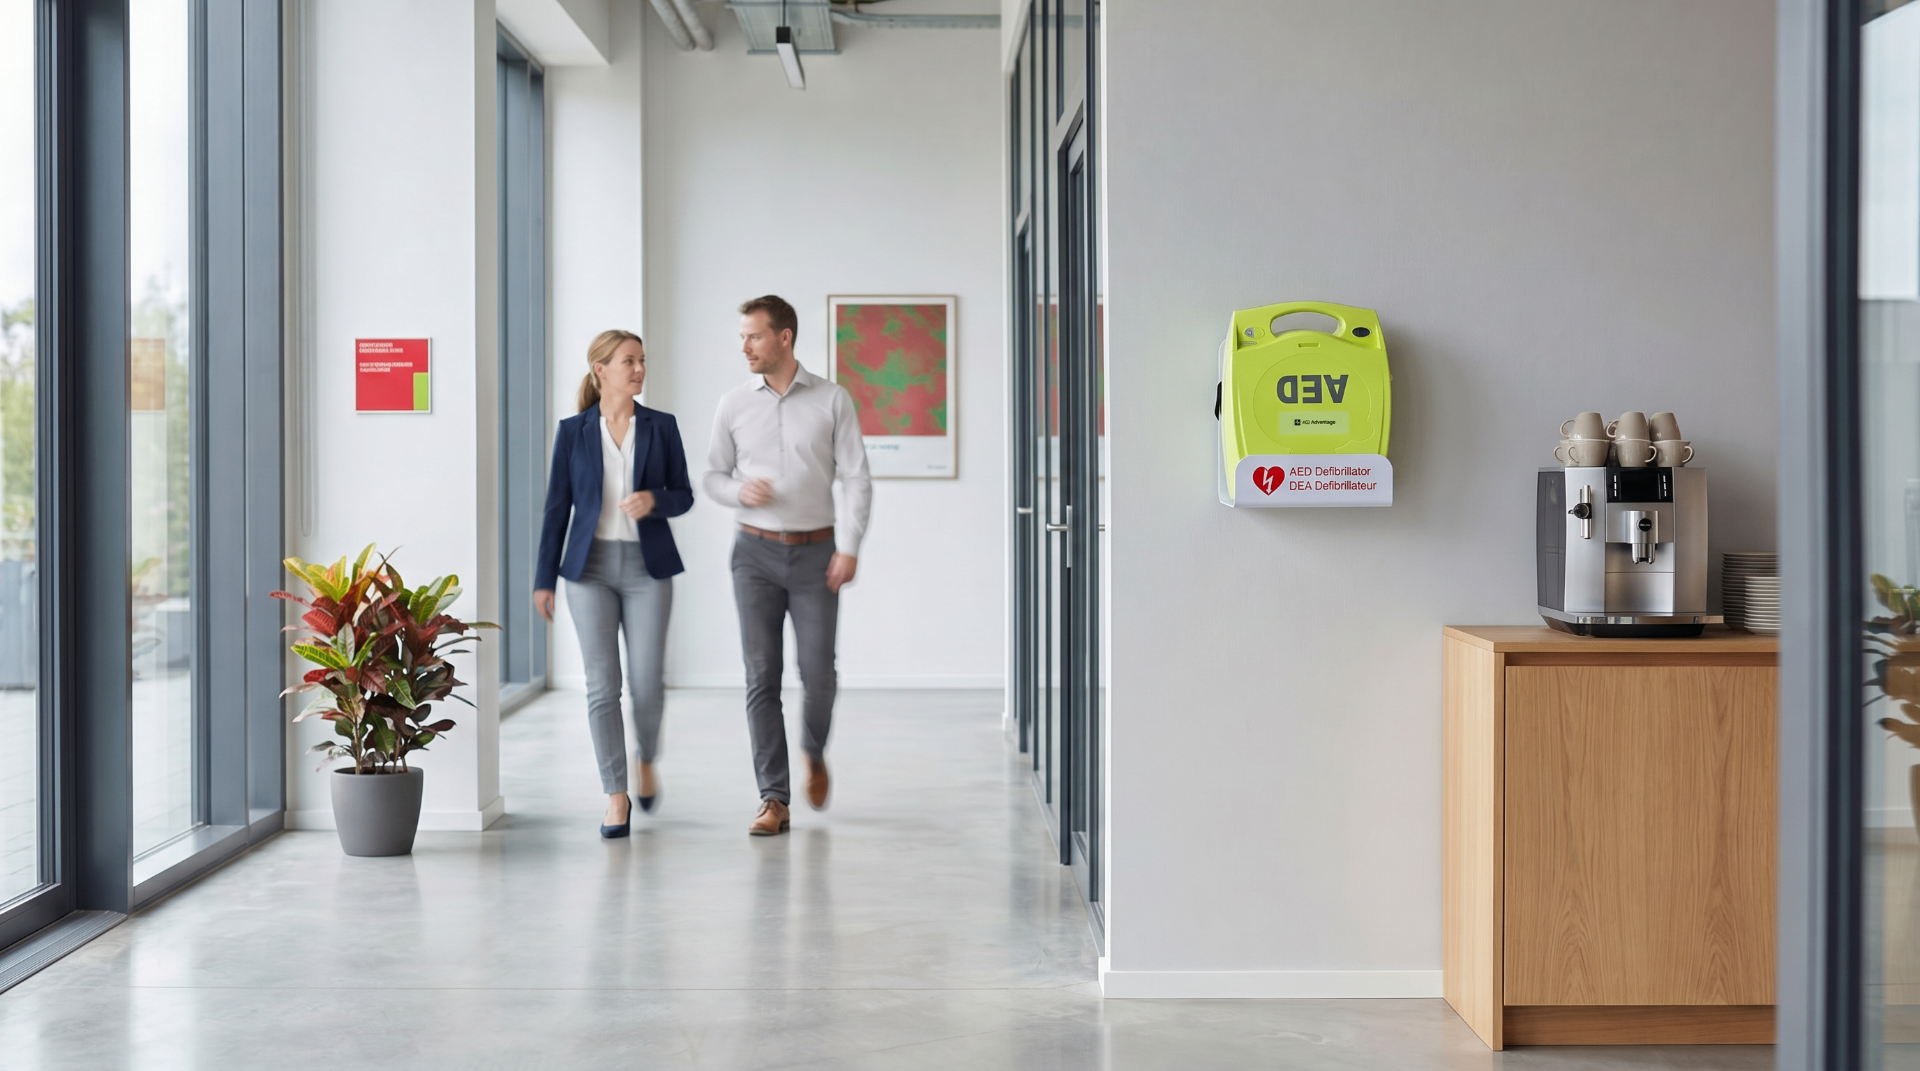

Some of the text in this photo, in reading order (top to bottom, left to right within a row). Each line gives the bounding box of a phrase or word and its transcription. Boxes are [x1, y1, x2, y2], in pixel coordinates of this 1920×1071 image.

[1276, 374, 1349, 404] AED
[1289, 466, 1371, 477] AED Defibrillator
[1289, 480, 1377, 491] DEA Defibrillateur
